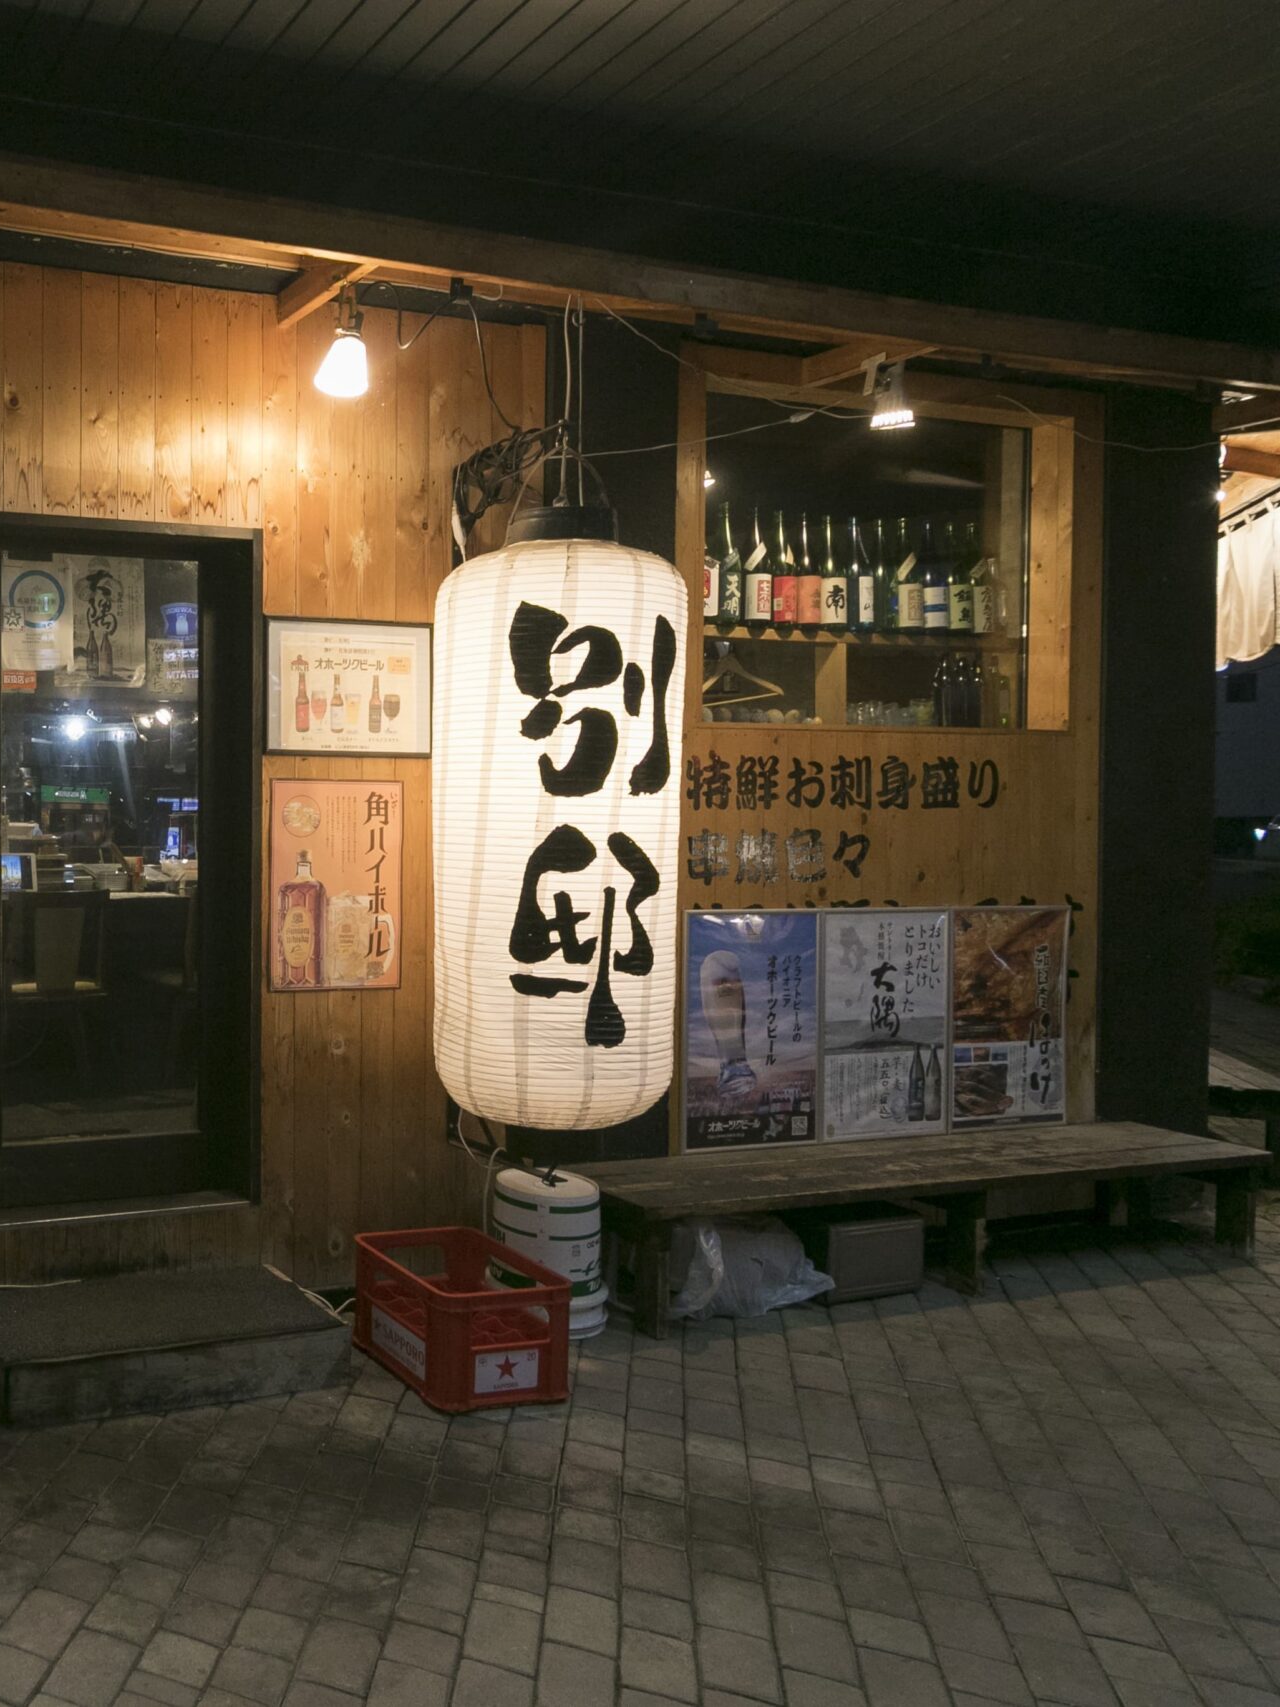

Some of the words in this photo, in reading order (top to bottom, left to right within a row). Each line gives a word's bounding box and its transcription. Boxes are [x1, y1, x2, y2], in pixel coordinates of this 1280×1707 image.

[314, 657, 384, 671] オホーツクビール
[509, 600, 676, 1049] 別邸
[363, 791, 391, 958] 角ハイボール
[783, 955, 791, 1008] パイオニア
[903, 926, 914, 1013] とりました
[917, 925, 927, 987] トコだけ
[929, 924, 941, 989] おいしい
[765, 955, 778, 1066] オホーツクビール
[793, 955, 801, 1042] クラフトビールの
[383, 1323, 425, 1367] SAPPORO
[527, 1351, 537, 1362] 20
